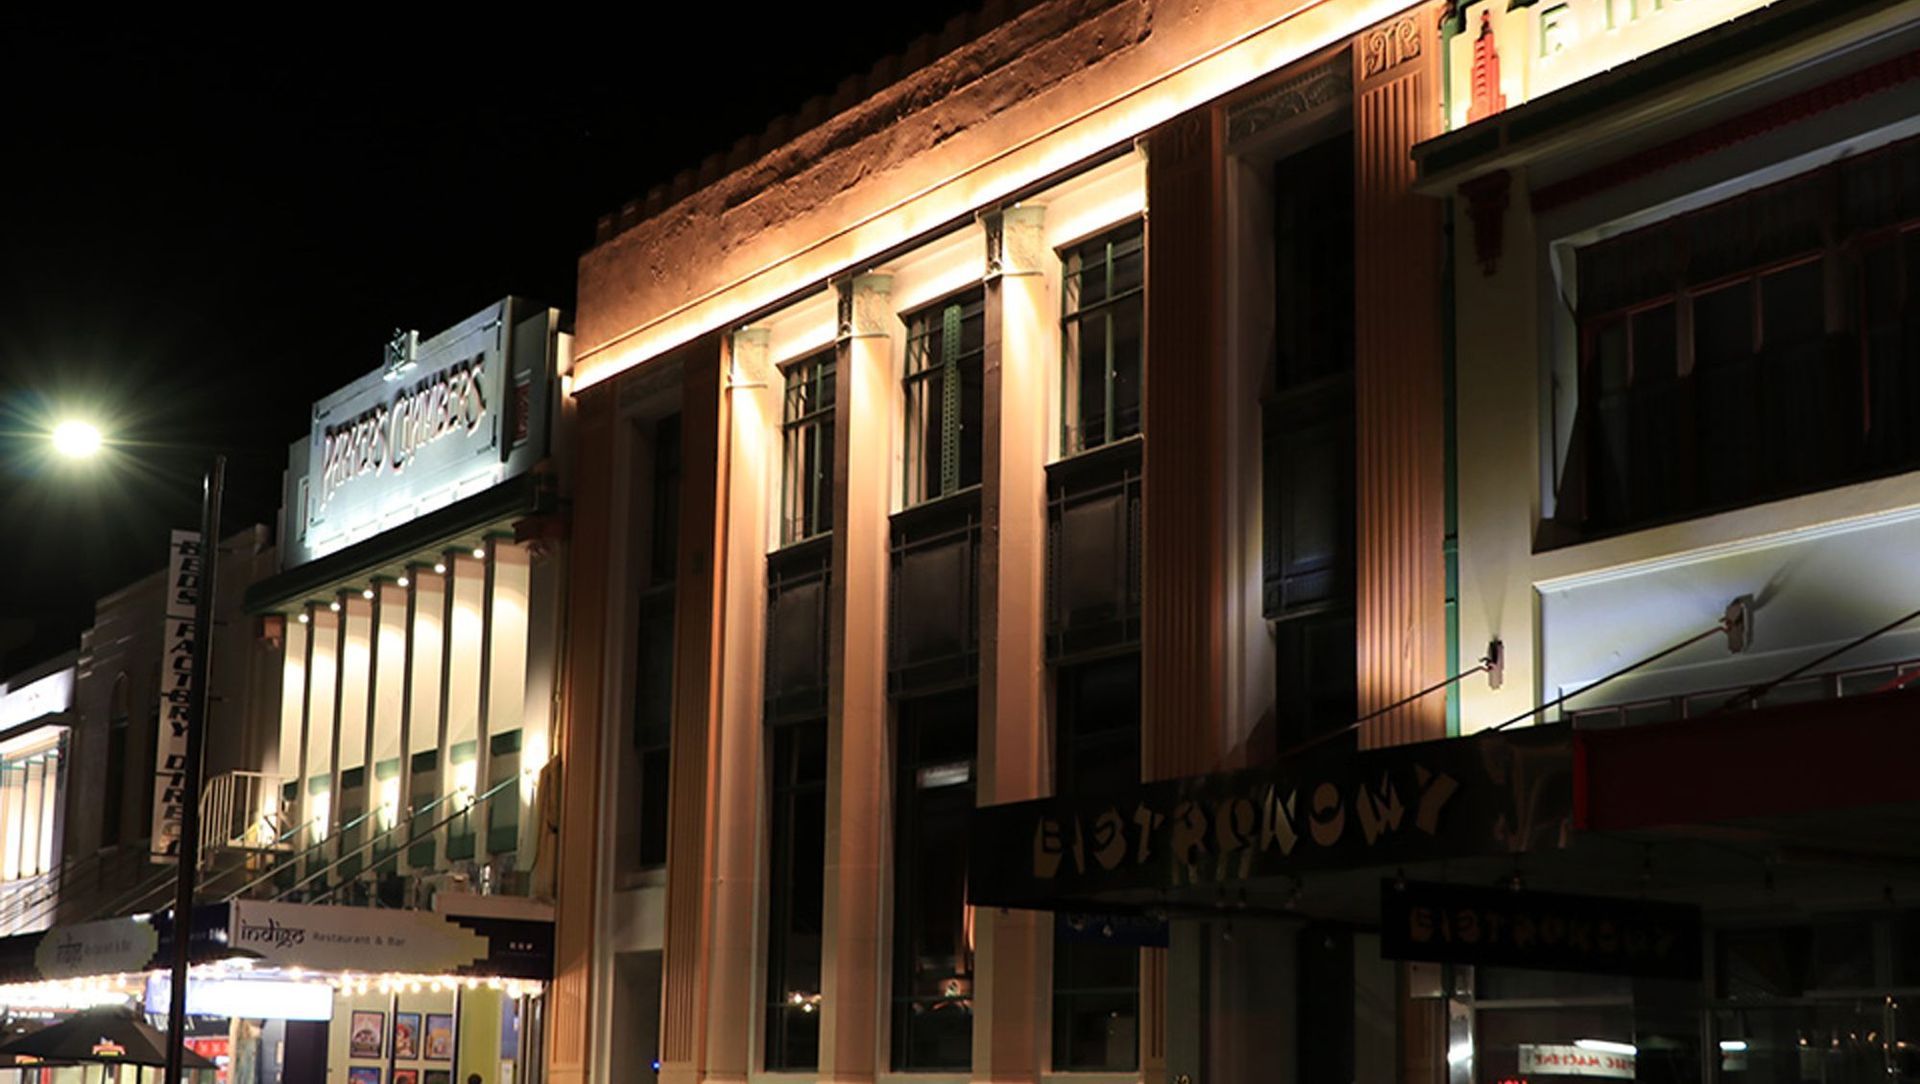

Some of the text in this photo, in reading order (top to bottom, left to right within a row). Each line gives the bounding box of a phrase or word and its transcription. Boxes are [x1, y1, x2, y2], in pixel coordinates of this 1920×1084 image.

[389, 356, 487, 475] CHAMBERS
[241, 908, 306, 949] indigo
[312, 931, 371, 946] Restaurant
[374, 933, 383, 946] &
[387, 934, 406, 947] Bar
